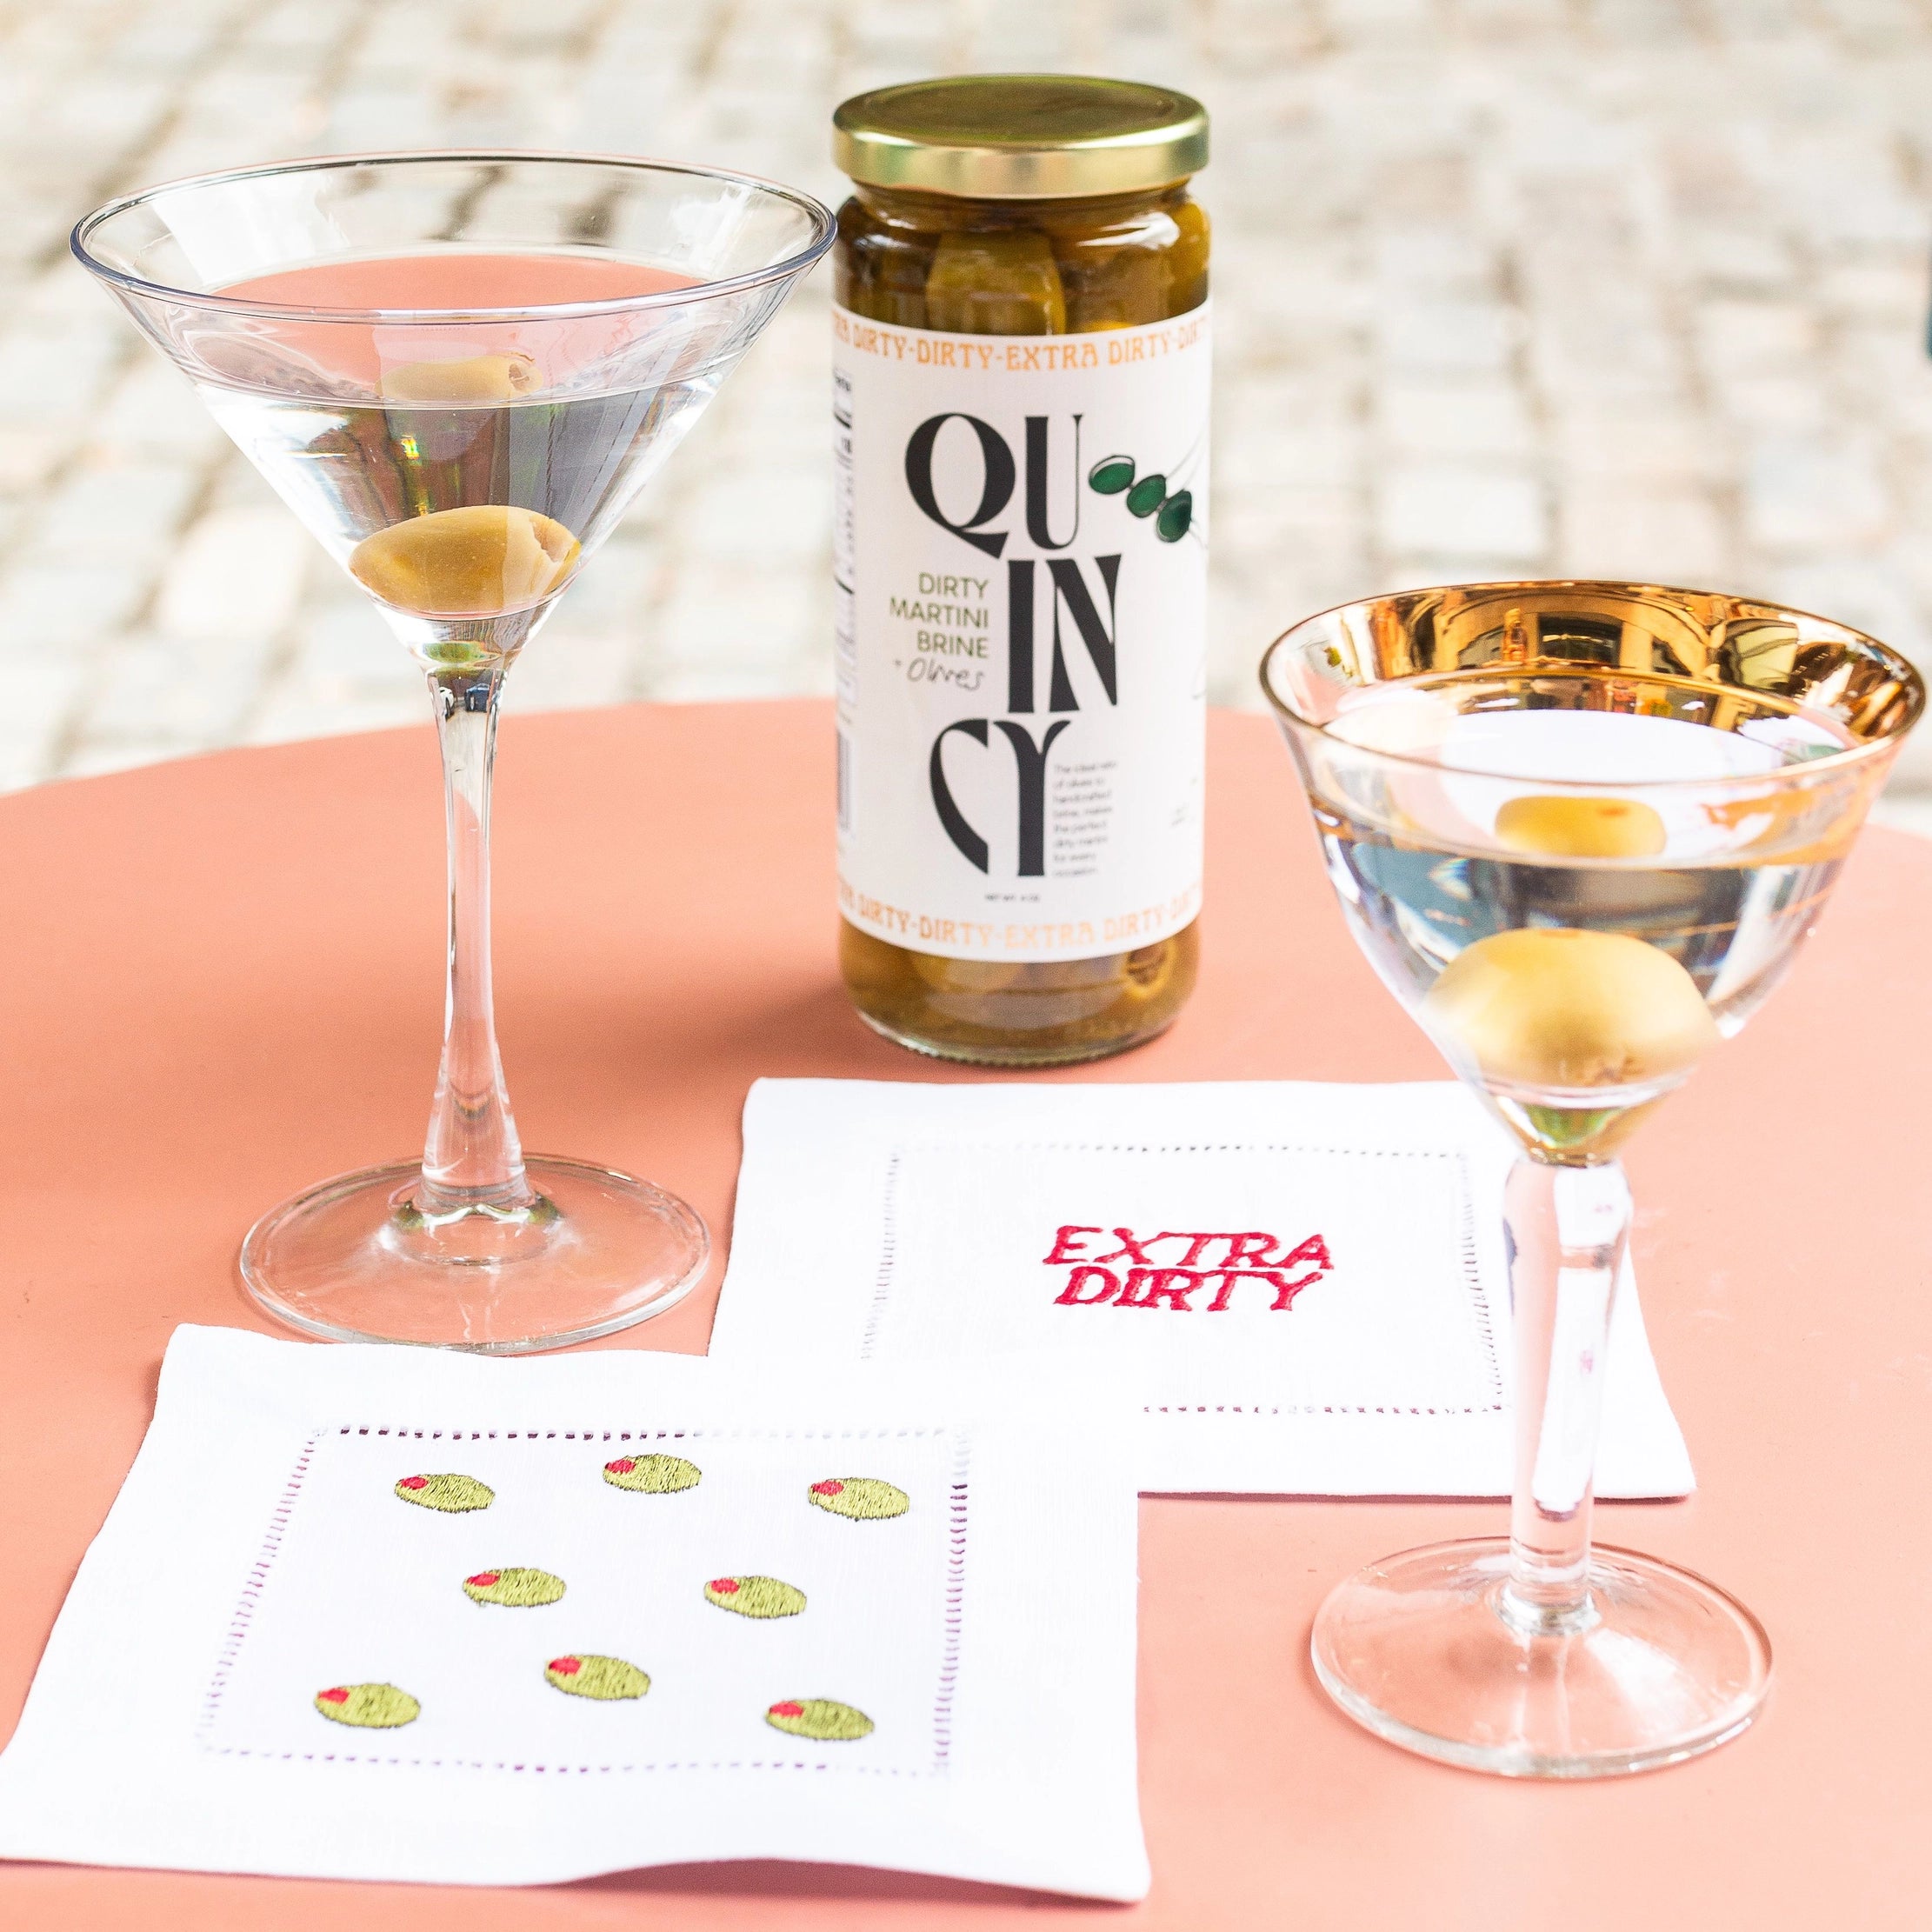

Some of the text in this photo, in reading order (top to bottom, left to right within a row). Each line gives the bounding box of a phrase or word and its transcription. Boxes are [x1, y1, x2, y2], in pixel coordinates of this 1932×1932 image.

[918, 571, 989, 600] DIRTY
[889, 596, 989, 629] MARTINI
[916, 630, 989, 659] BRINE
[1043, 1225, 1335, 1269] EXTRA
[1053, 1266, 1323, 1311] DIRTY
